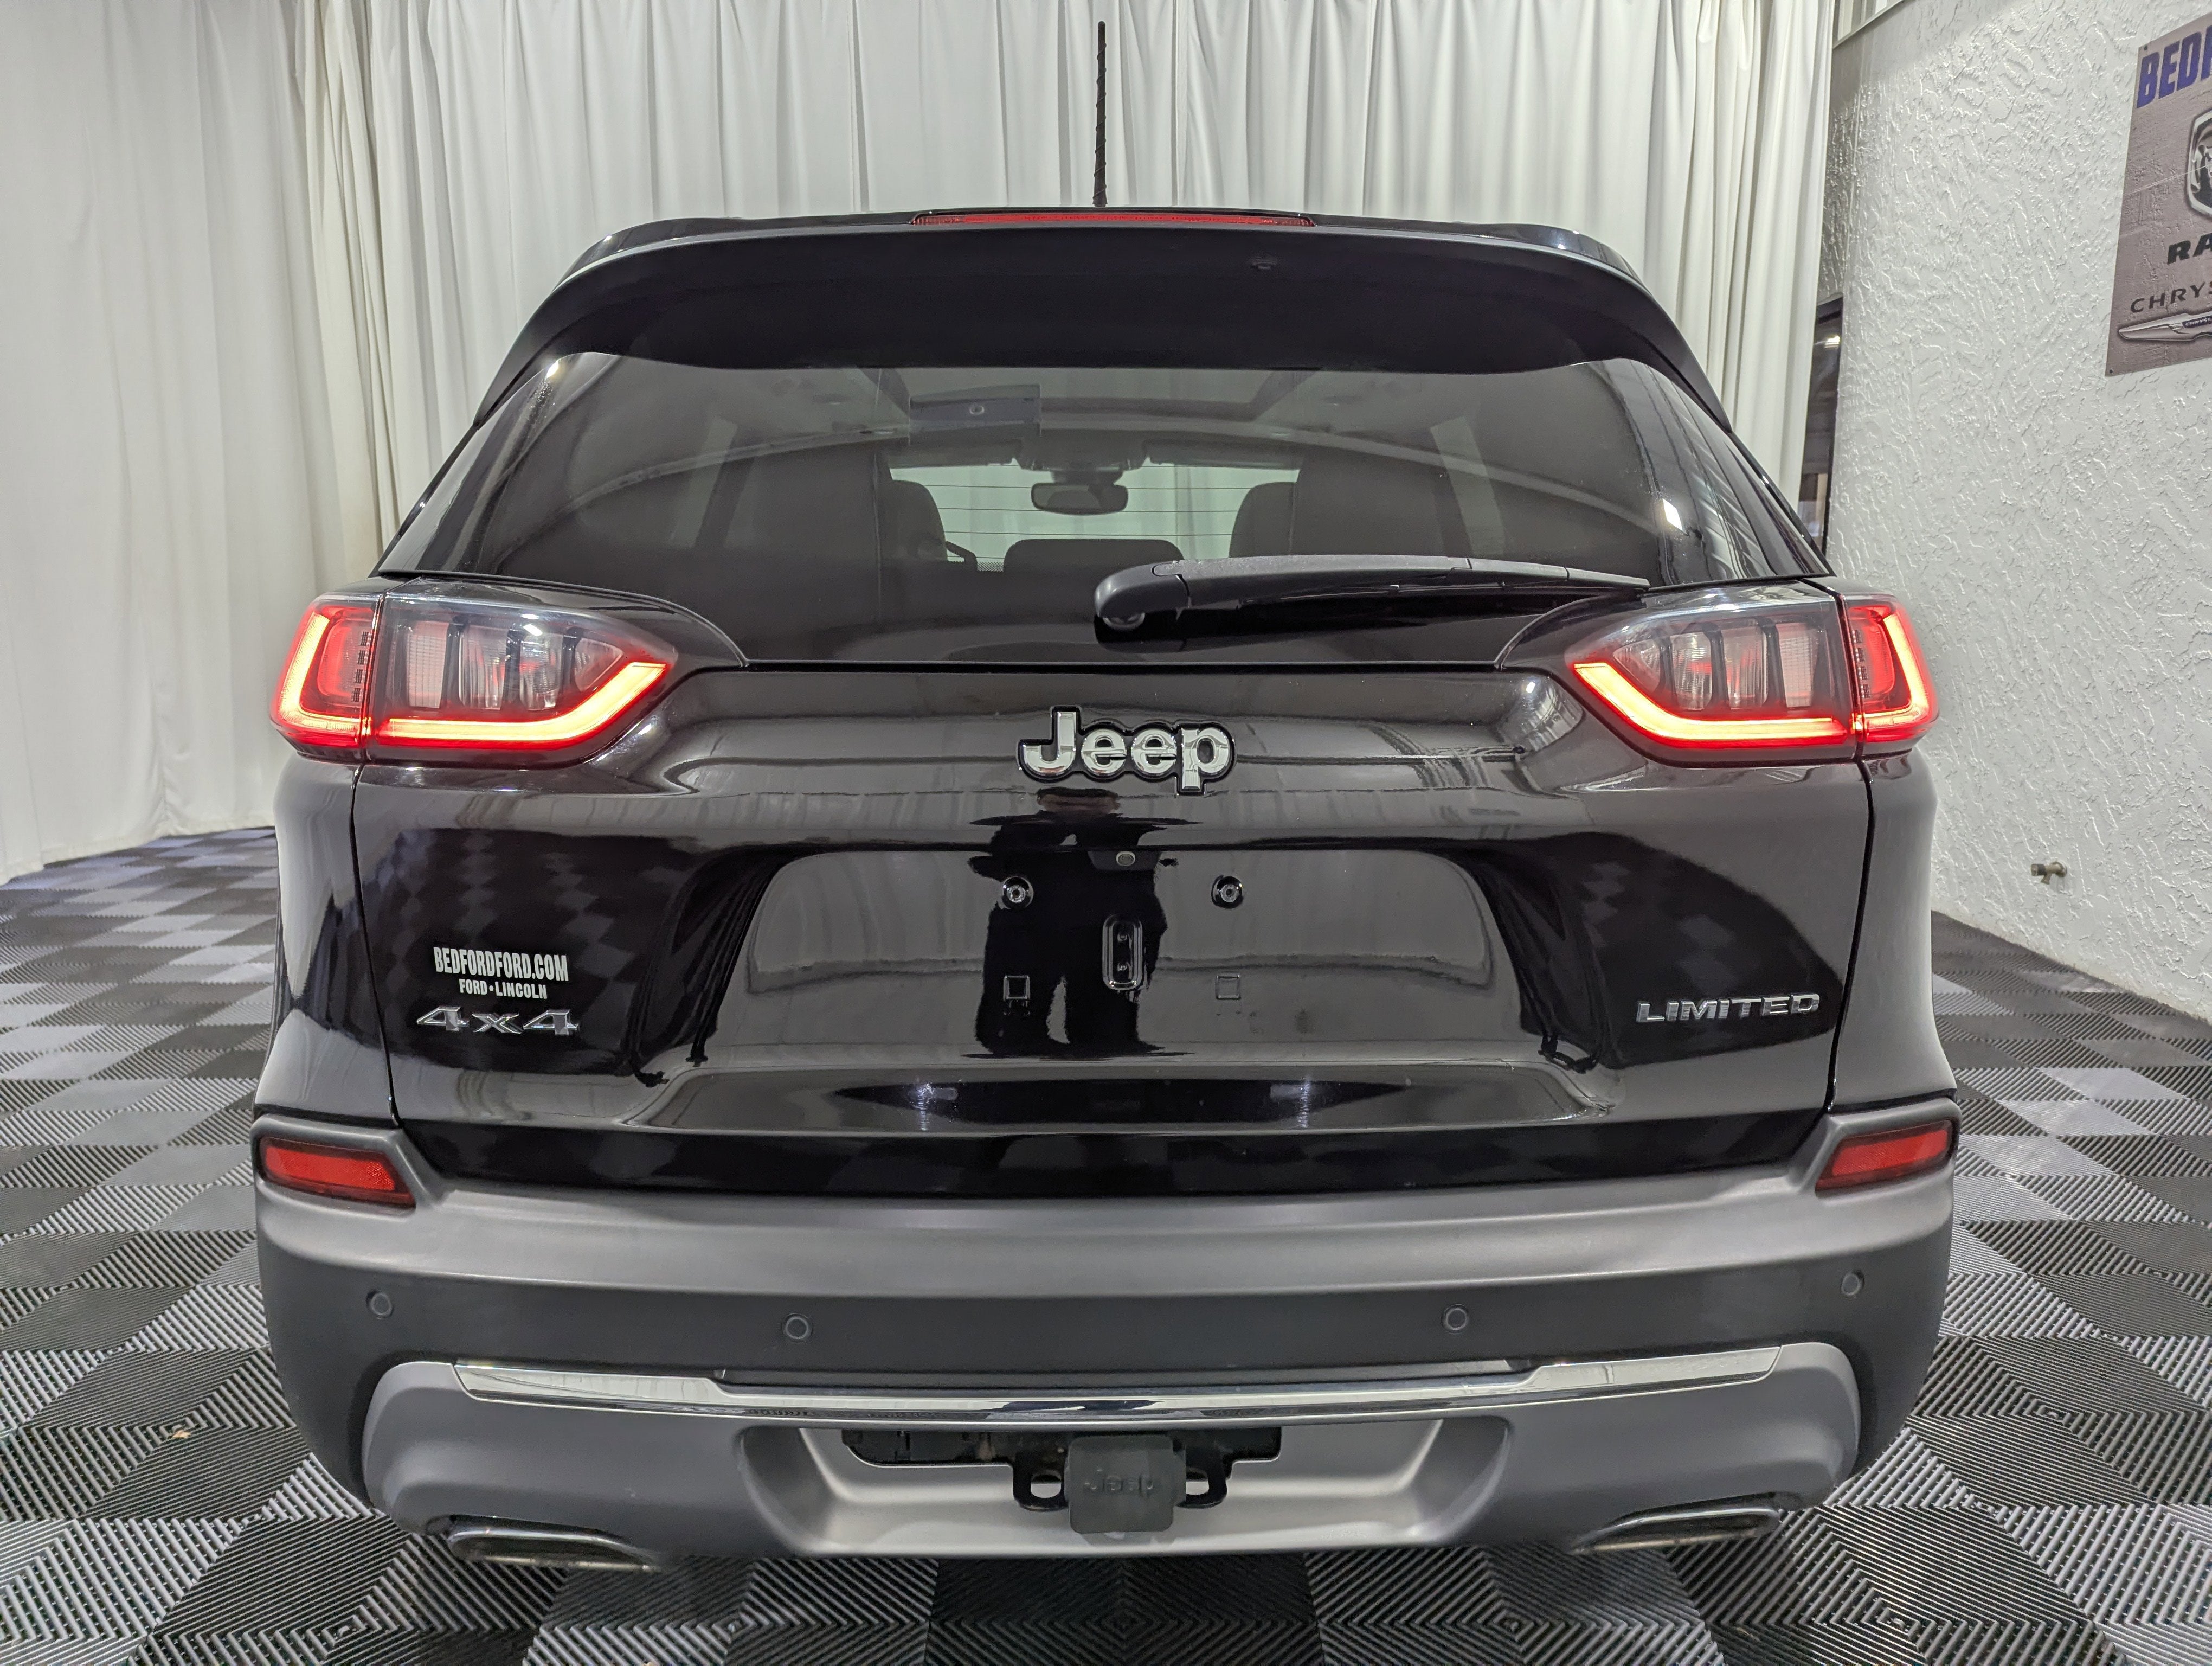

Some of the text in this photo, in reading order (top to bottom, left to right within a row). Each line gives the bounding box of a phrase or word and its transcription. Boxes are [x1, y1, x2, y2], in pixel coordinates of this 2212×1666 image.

[1021, 708, 1232, 791] Jeep
[433, 946, 569, 982] BEDFORDFORD.COM
[1636, 993, 1820, 1023] LIMITED
